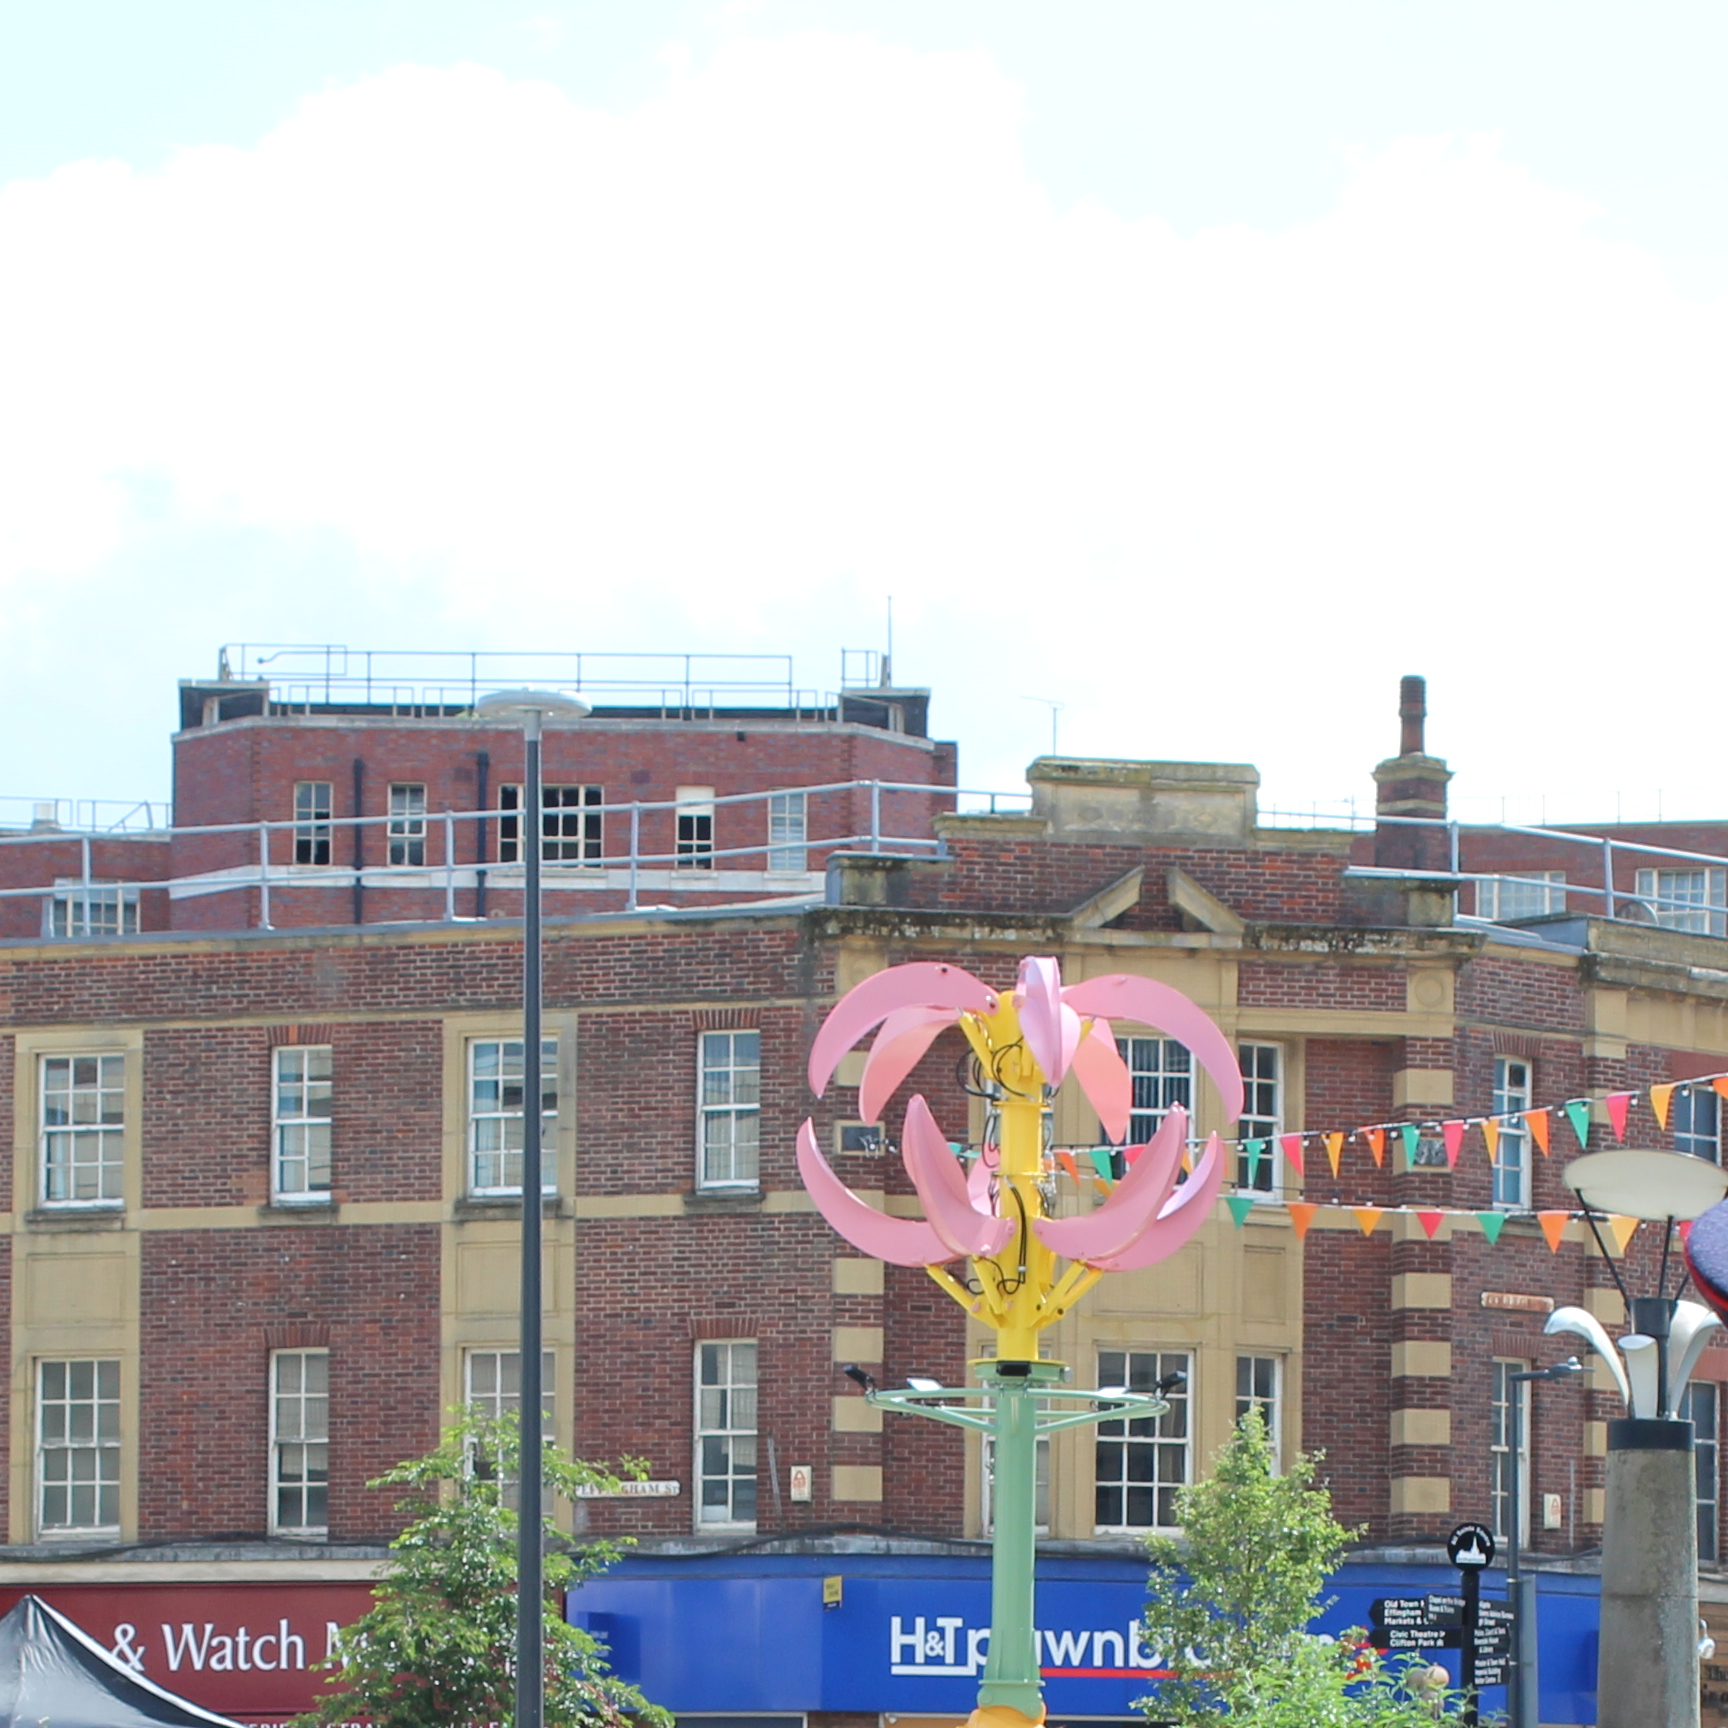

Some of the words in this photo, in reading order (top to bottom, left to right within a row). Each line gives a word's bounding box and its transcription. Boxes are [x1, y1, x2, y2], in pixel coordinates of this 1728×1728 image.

[111, 1623, 146, 1672] &
[161, 1618, 305, 1672] Watch
[891, 1616, 963, 1664] H&T
